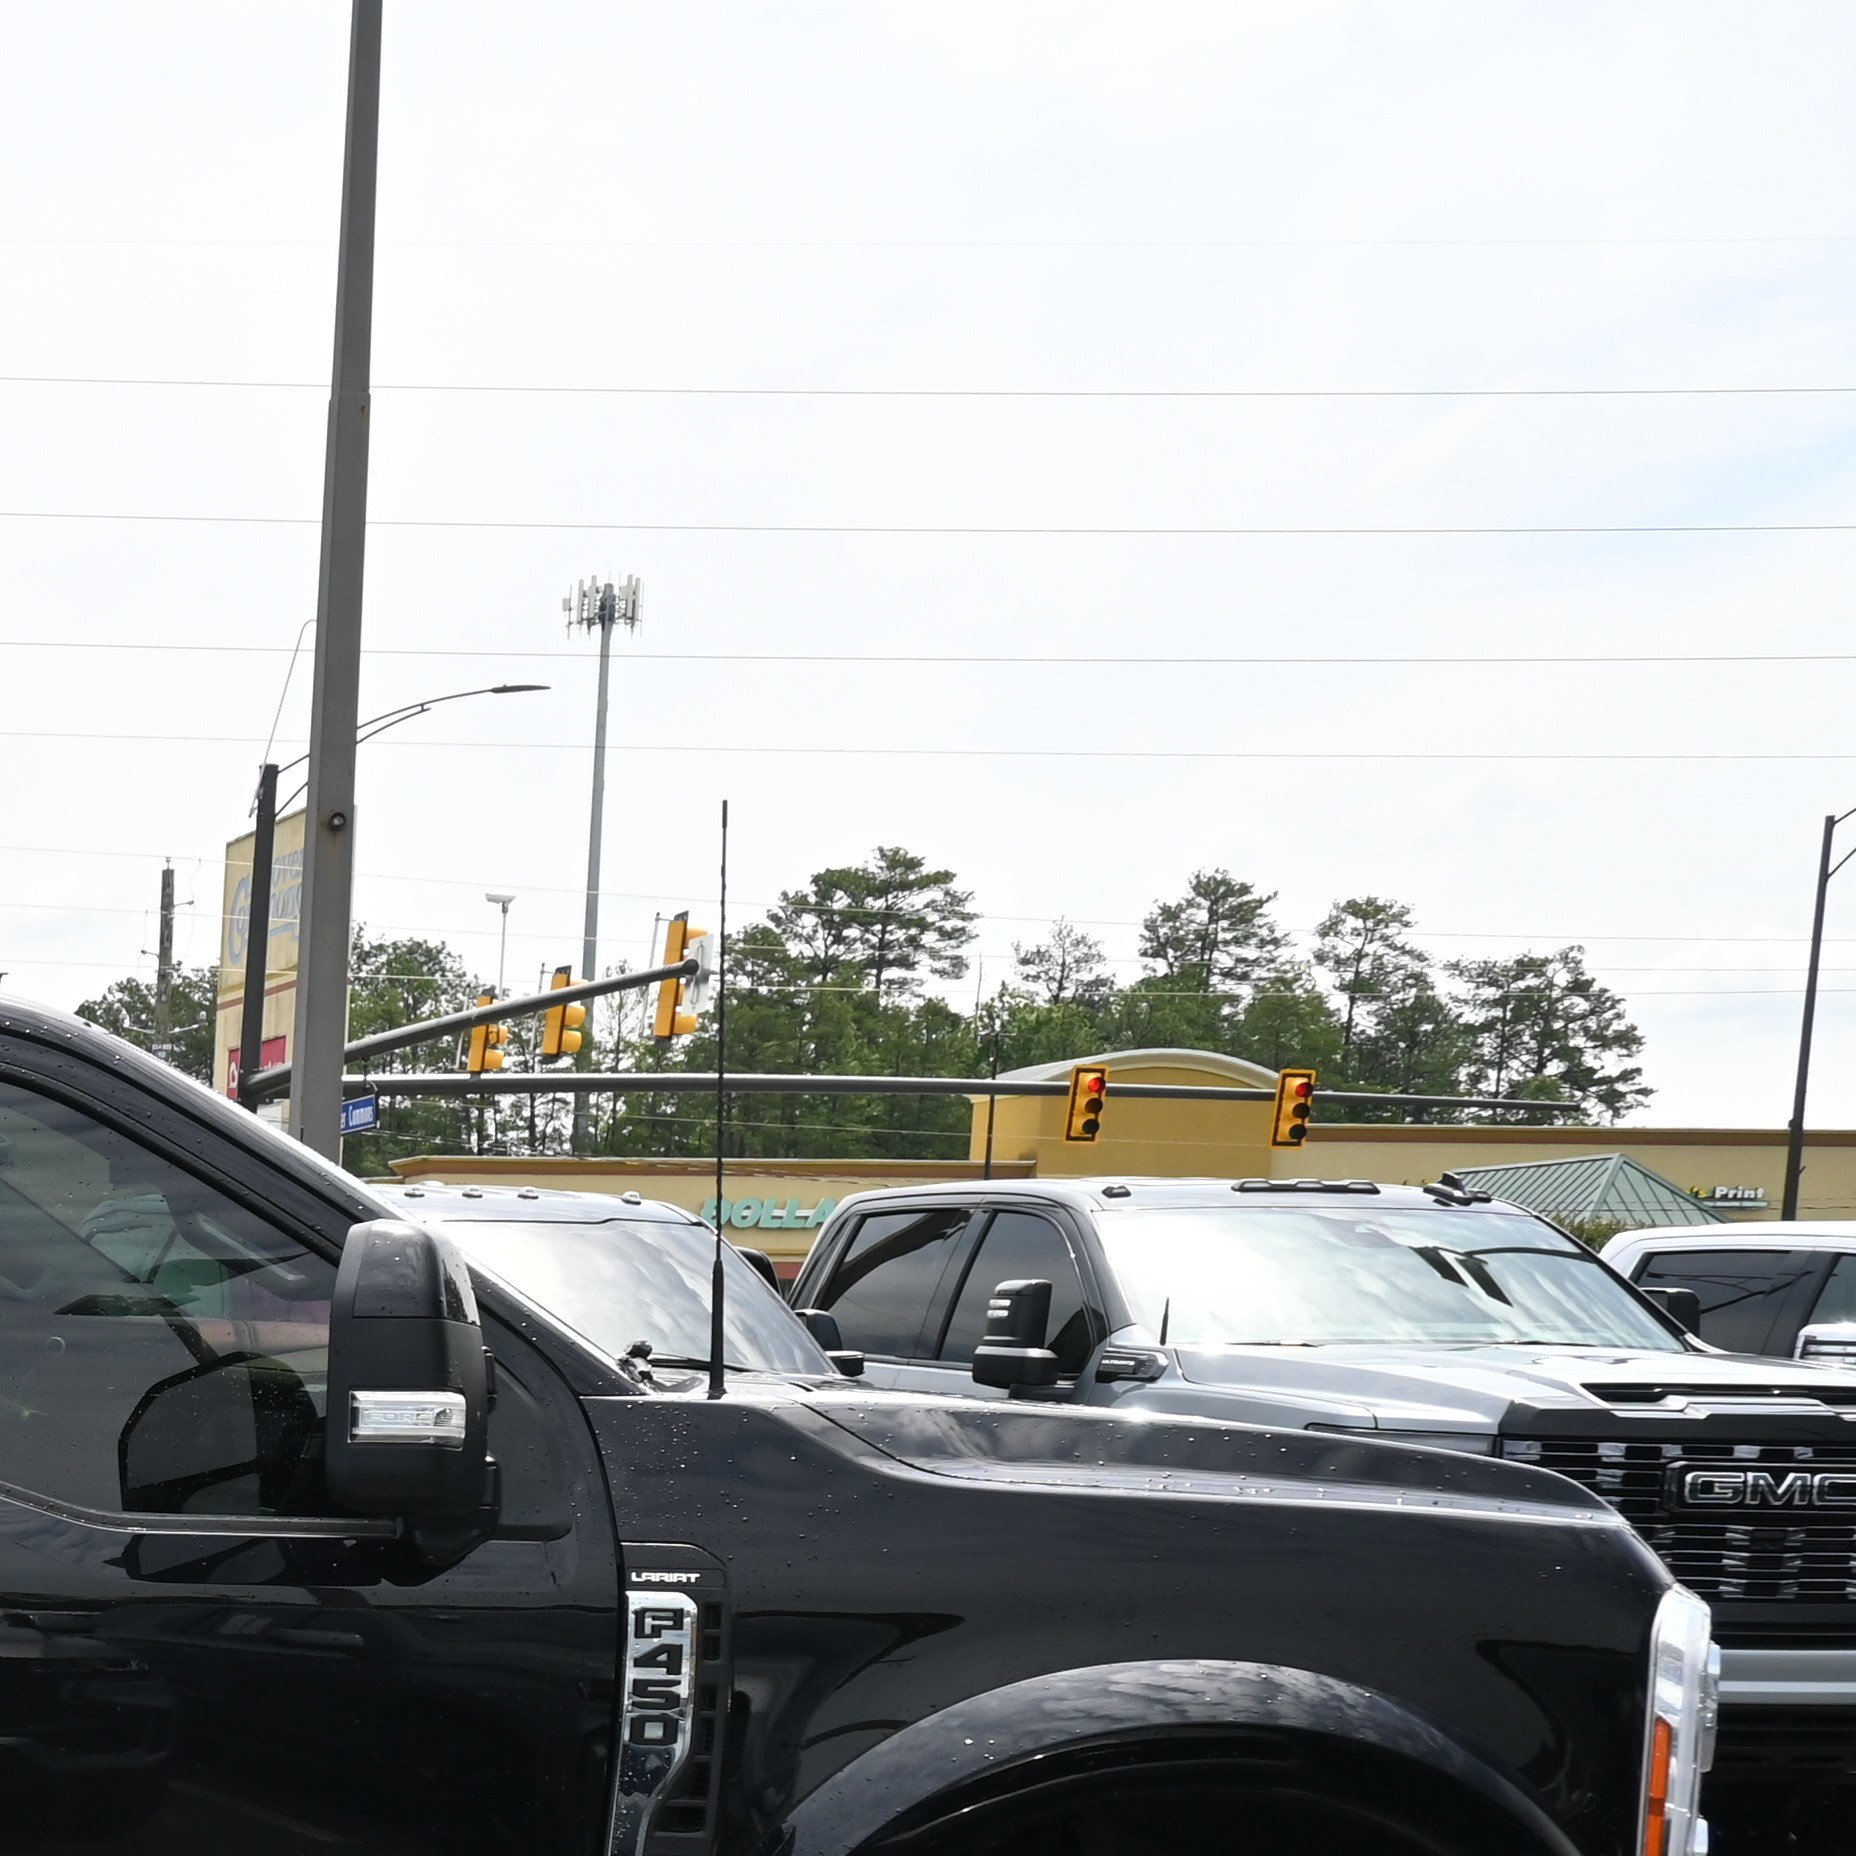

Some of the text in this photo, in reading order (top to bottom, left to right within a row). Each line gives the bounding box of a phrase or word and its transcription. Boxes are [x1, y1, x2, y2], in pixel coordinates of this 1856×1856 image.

[1714, 1186, 1765, 1199] Print
[700, 1197, 838, 1229] DOLLA
[1684, 1471, 1856, 1506] GMC
[631, 1572, 700, 1583] LARIAT
